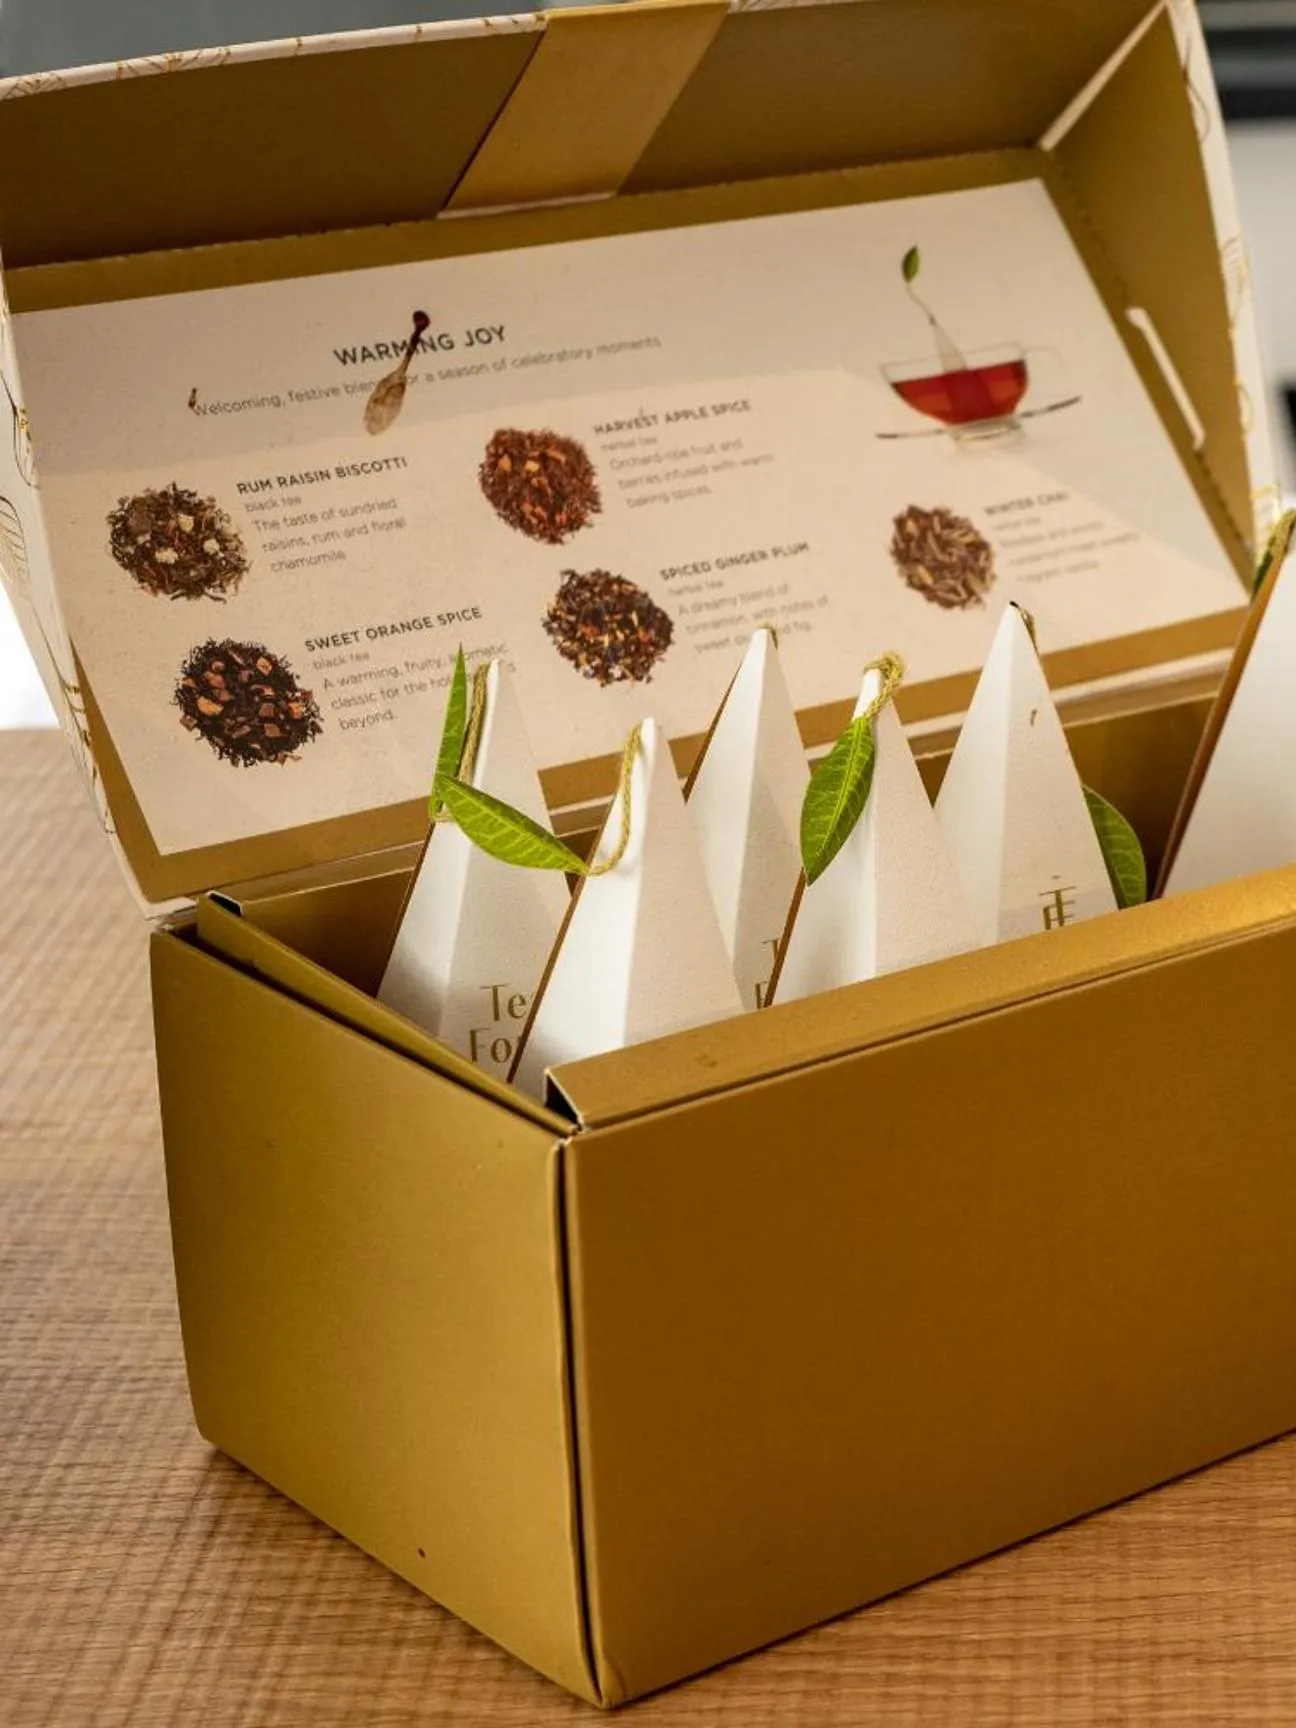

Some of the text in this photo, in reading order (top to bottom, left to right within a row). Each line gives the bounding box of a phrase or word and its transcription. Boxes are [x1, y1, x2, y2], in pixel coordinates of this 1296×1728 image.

[333, 325, 506, 366] WARMNG JOY
[191, 391, 287, 417] Welcoming,
[288, 384, 341, 403] festive
[425, 372, 434, 382] a
[437, 361, 490, 380] season
[492, 356, 508, 371] of
[511, 346, 594, 369] celebratory
[596, 336, 662, 356] moments
[593, 399, 752, 435] HARVEST APPLE SPICE
[236, 456, 408, 496] RUM RAISIN BISCOTTI
[244, 494, 302, 512] black tea
[252, 498, 398, 533] The taste of sundried
[262, 516, 407, 553] raisins, rum and floral
[659, 541, 810, 582] SPICED GINGER PLUM
[304, 606, 483, 652] SWEET ORANGE SPICE
[313, 651, 370, 670] black tea
[323, 677, 335, 691] A
[338, 666, 404, 686] warming,
[331, 678, 428, 711] classic for the
[339, 708, 398, 731] beyond.
[479, 983, 533, 1022] Te
